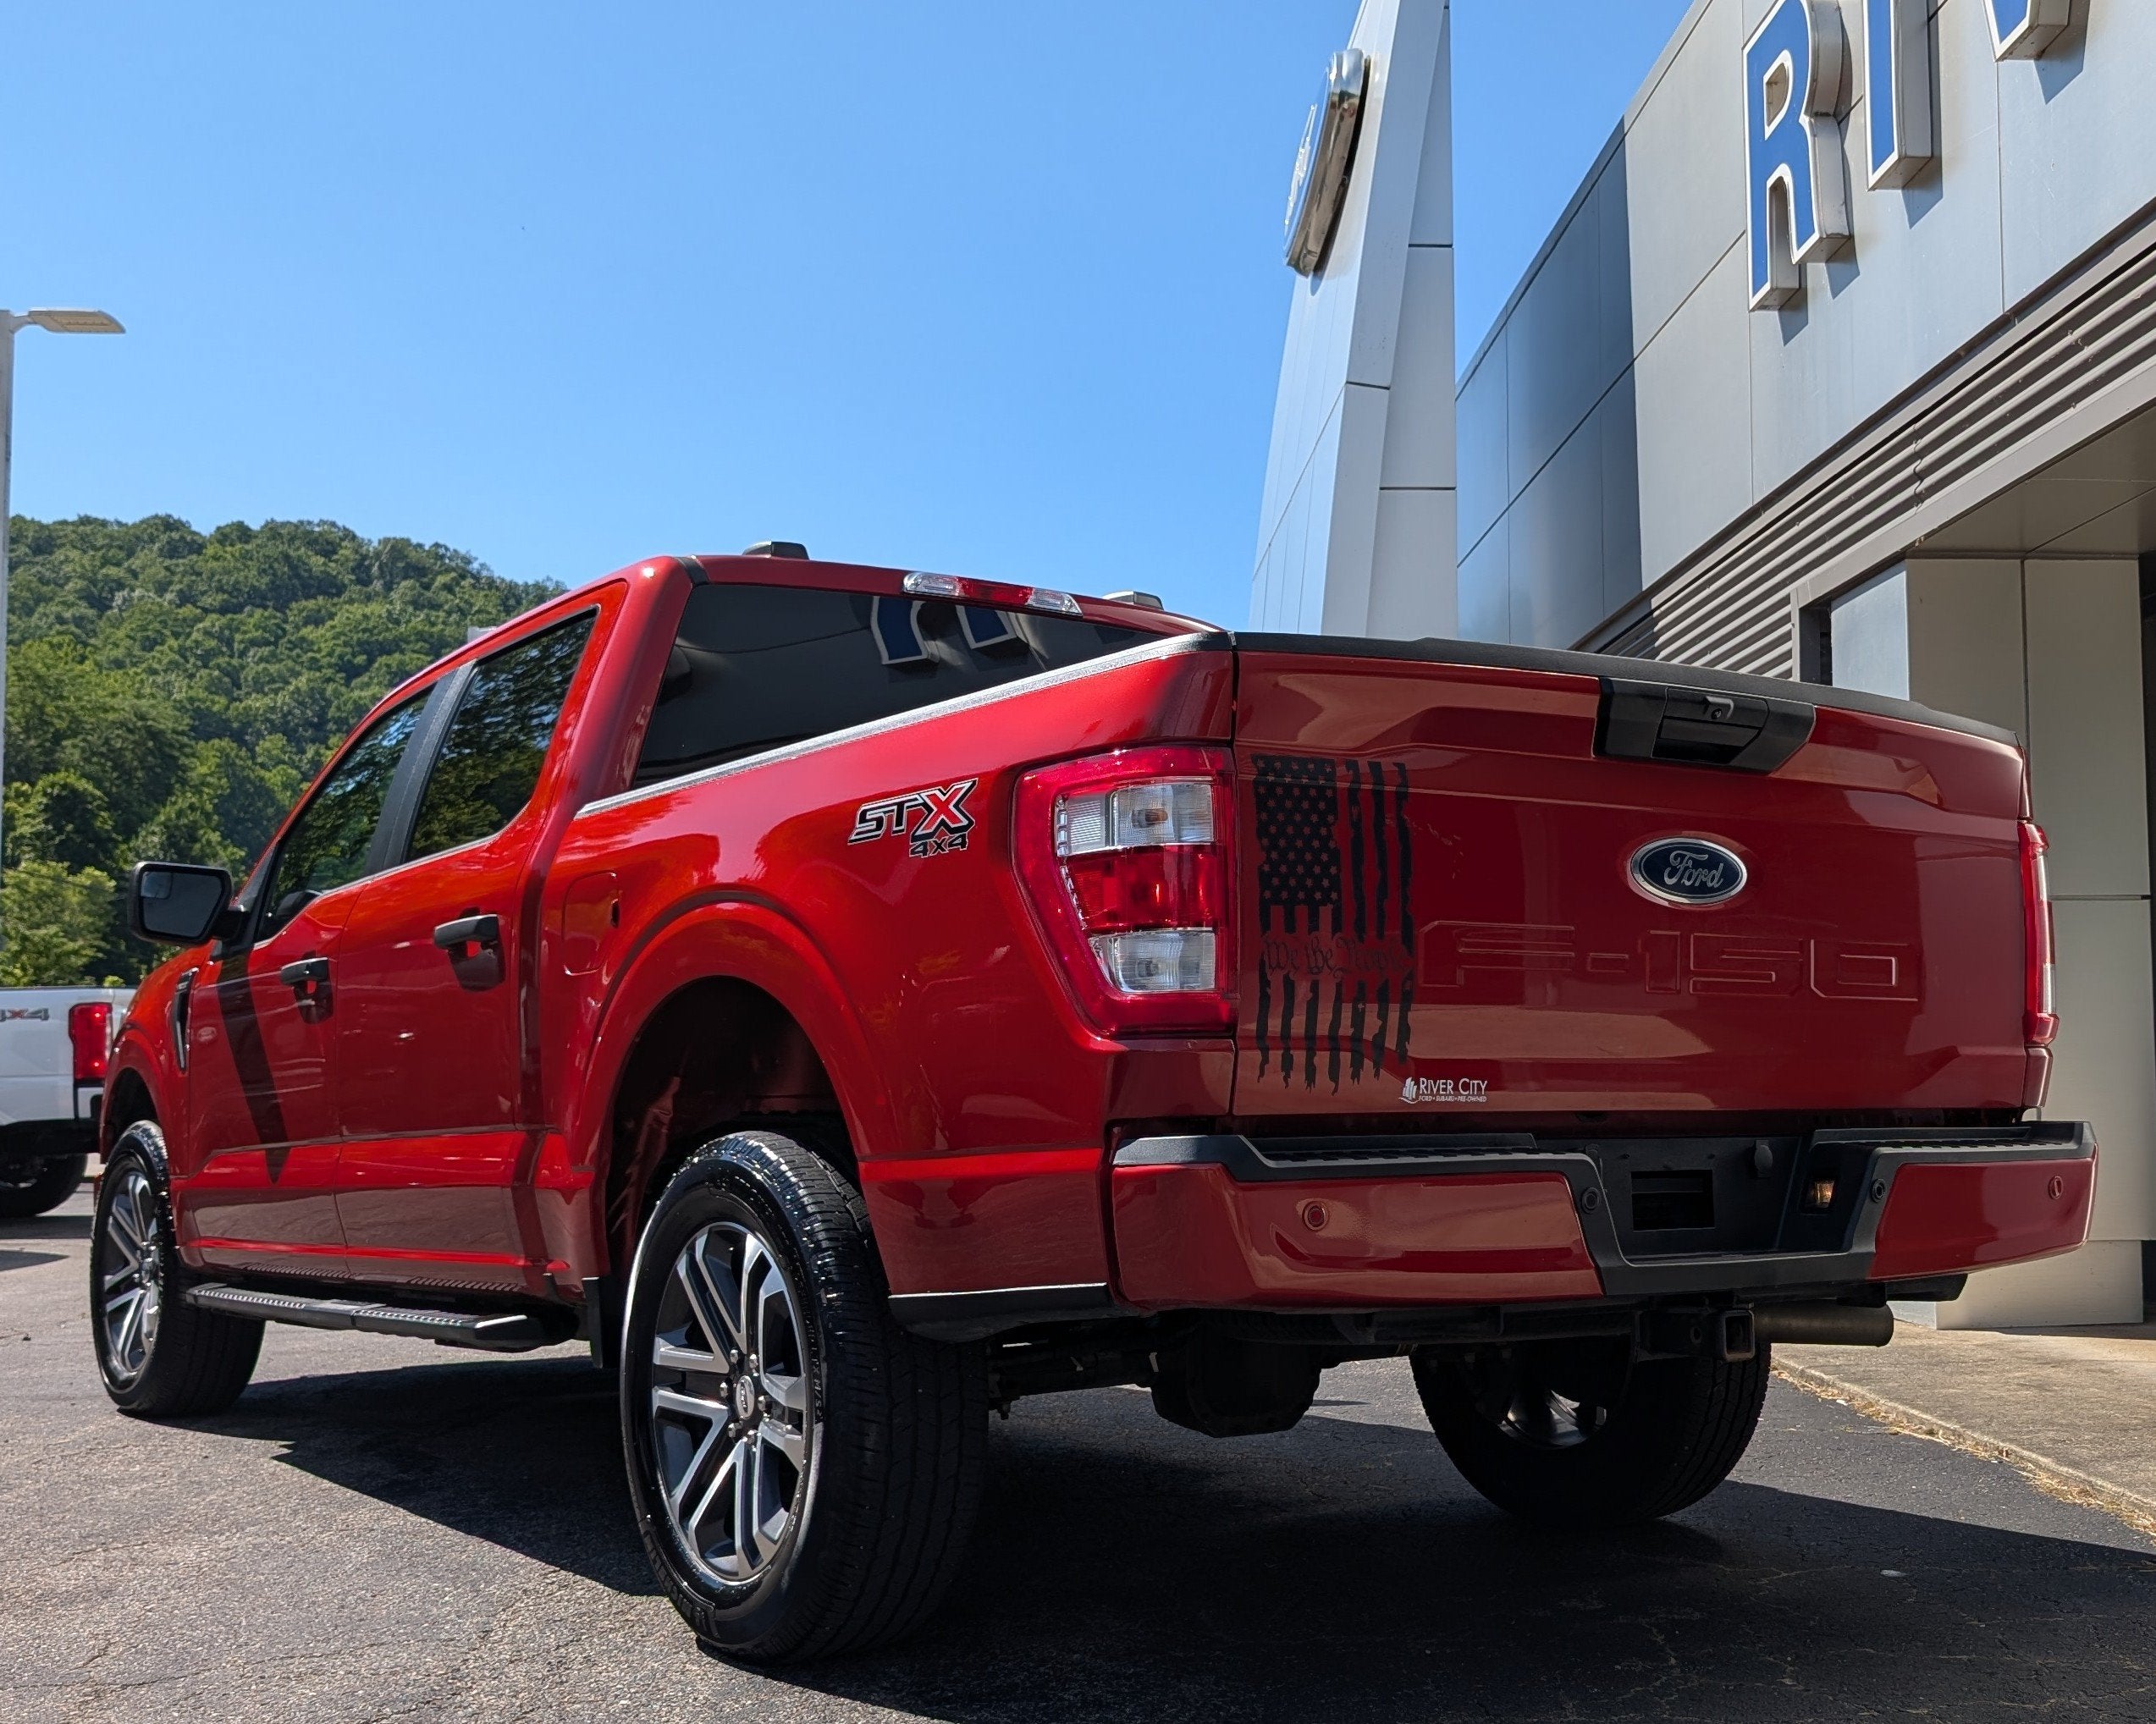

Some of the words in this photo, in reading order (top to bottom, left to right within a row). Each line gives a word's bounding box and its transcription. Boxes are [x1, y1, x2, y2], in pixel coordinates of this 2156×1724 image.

[1742, 0, 2071, 311] RI
[847, 778, 979, 845] STX
[1664, 850, 1724, 888] Ford
[1417, 920, 1922, 1001] F-150
[1419, 1077, 1454, 1094] RIVER
[1458, 1077, 1488, 1095] CITY
